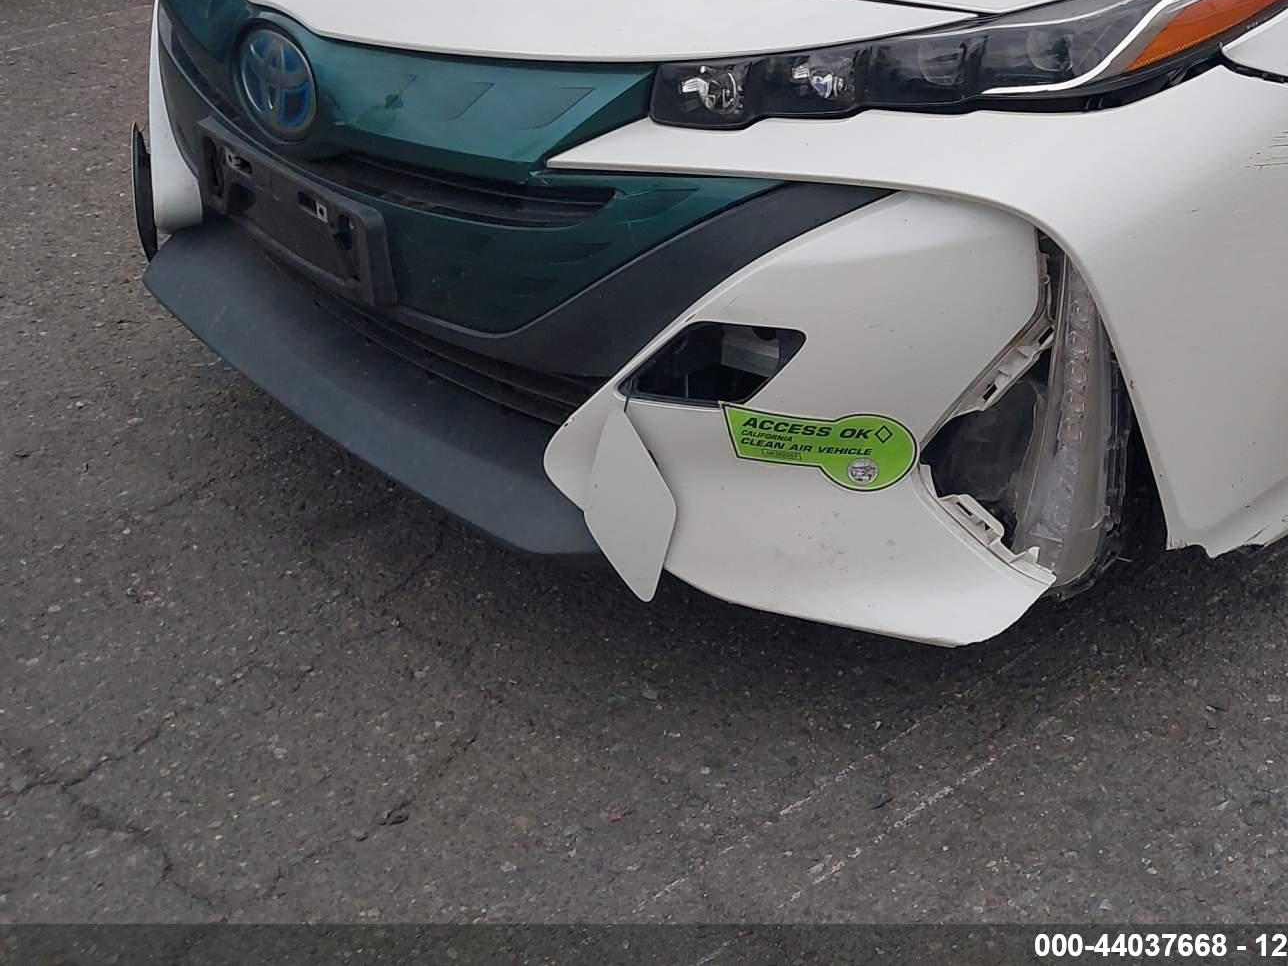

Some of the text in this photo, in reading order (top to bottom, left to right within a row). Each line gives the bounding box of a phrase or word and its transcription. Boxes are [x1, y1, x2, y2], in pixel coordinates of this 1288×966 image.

[740, 429, 793, 442] CALIFORNIA
[741, 417, 874, 440] ACCESS OK
[740, 437, 873, 456] CLEAN AIR VEHICLE
